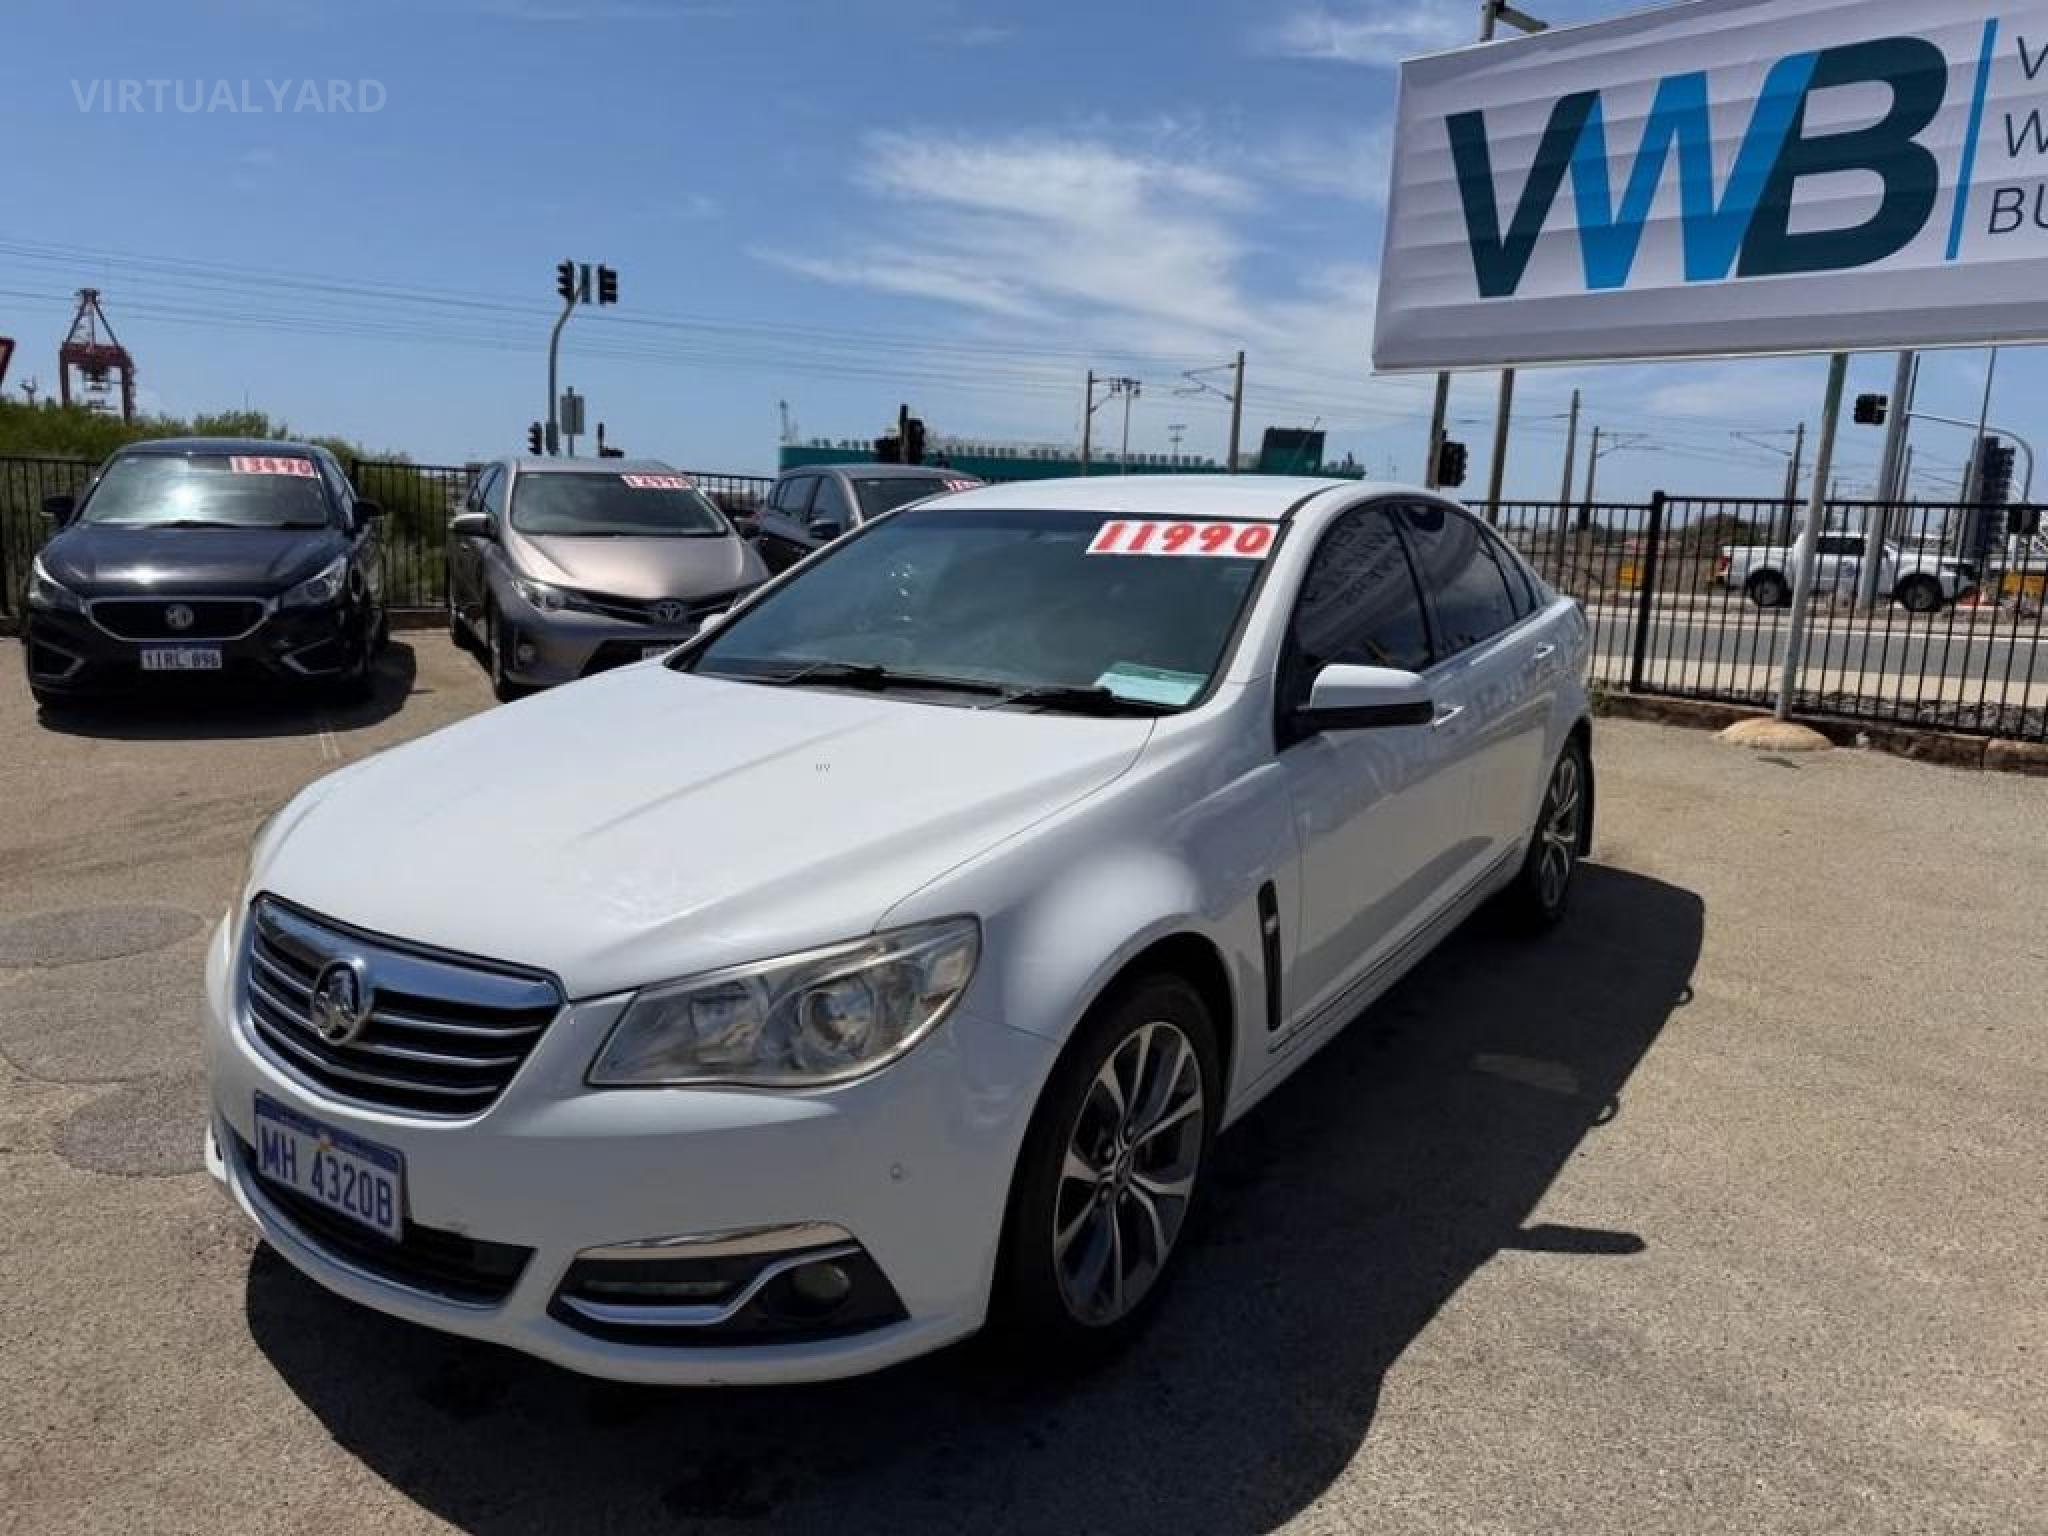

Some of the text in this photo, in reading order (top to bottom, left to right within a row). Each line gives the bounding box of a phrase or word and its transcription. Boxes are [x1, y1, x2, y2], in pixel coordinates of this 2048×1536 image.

[1445, 36, 1948, 299] VWB
[1096, 522, 1271, 555] 11990
[261, 1124, 298, 1184] MH
[311, 1149, 393, 1227] 4320B
